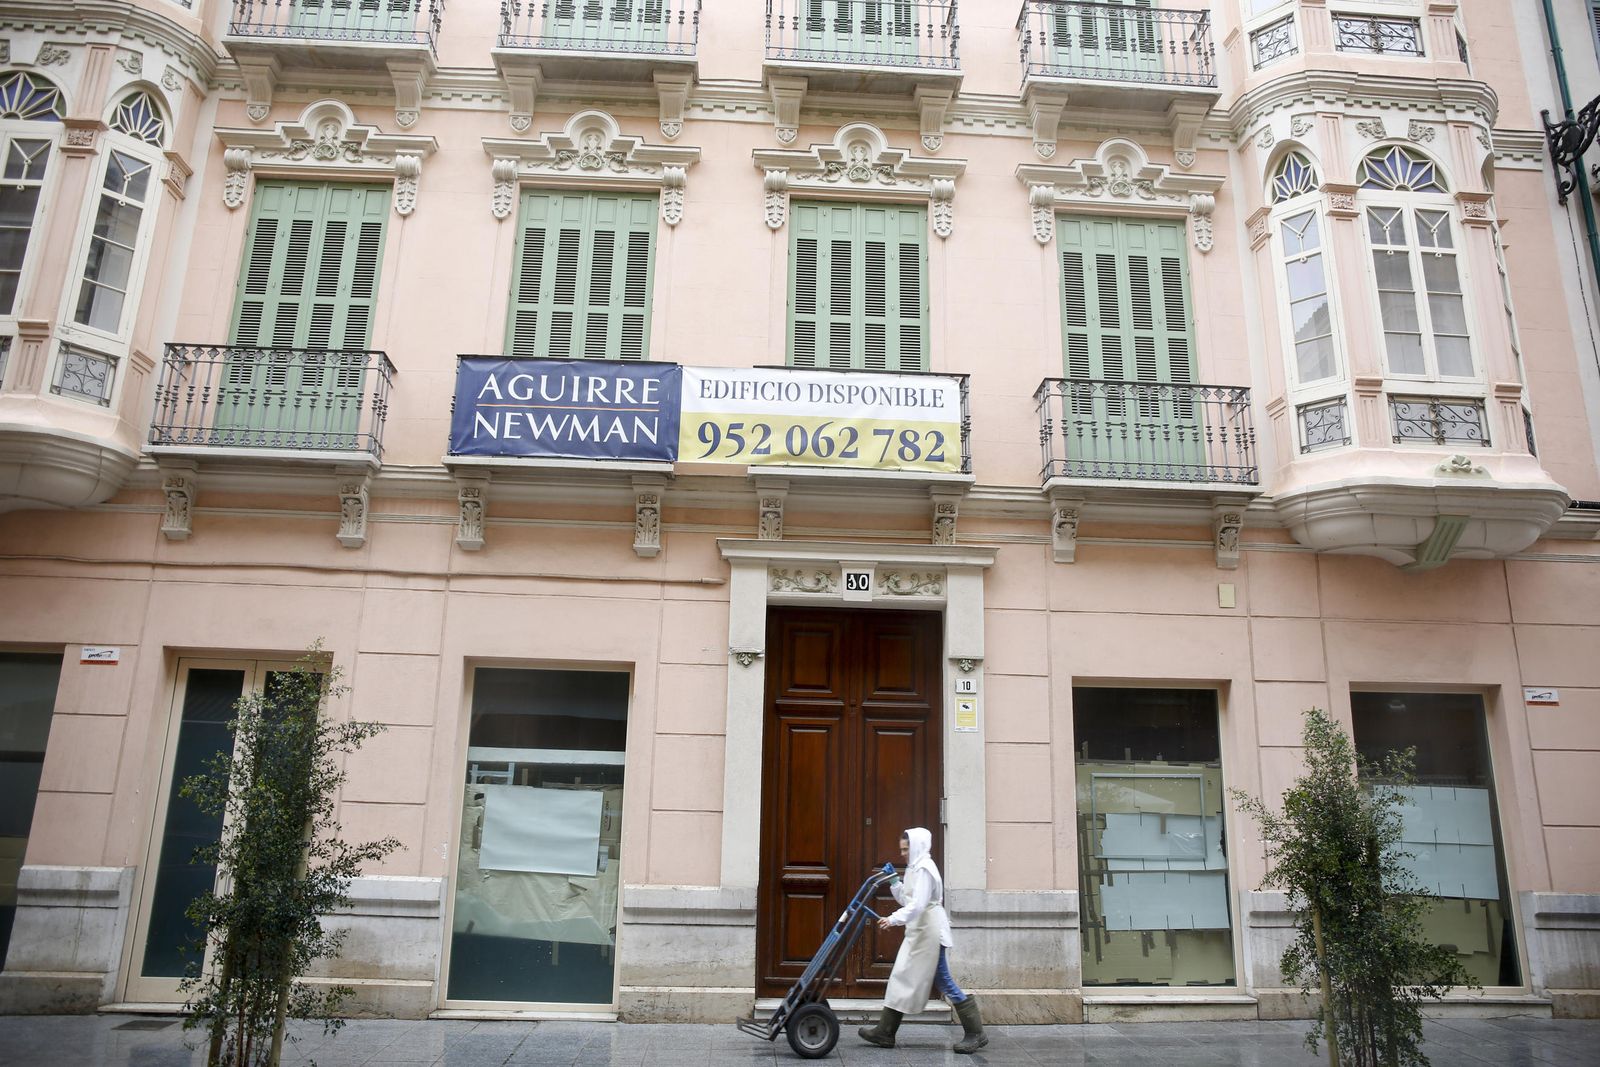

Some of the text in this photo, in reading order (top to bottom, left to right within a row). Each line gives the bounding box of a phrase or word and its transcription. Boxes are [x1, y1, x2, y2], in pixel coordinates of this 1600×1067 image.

[477, 373, 660, 405] AGUIRRE
[699, 378, 945, 409] EDIFICIO DISPONIBLE
[473, 410, 659, 445] NEWMAN
[697, 421, 945, 463] 952 062 782
[962, 681, 971, 691] 10
